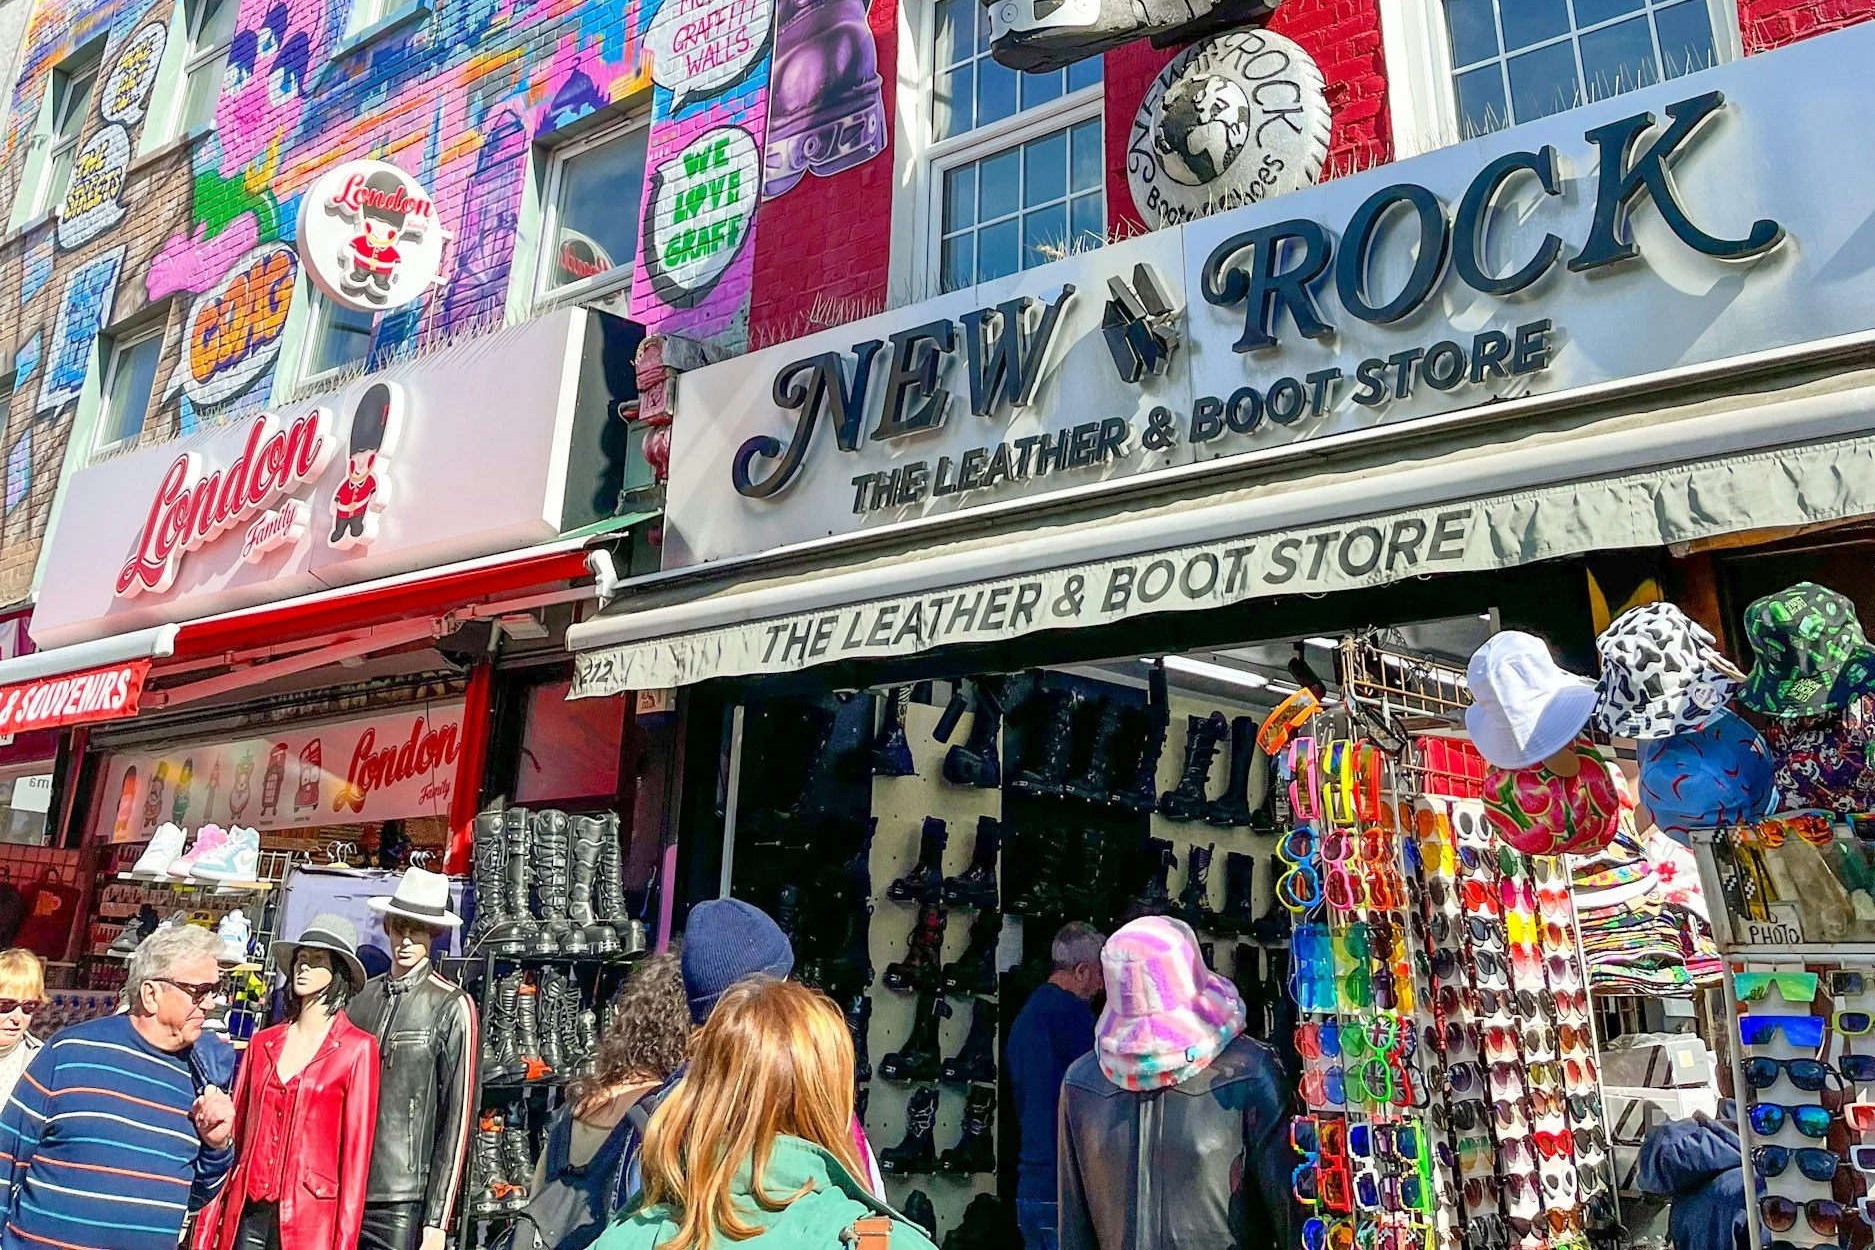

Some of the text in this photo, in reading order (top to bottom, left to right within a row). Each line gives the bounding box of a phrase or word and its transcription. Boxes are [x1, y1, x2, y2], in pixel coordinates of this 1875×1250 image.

[686, 26, 755, 77] WALLS.
[1223, 31, 1304, 149] ROCK
[683, 137, 731, 180] WE
[332, 172, 434, 218] London
[672, 168, 741, 225] LOVE
[663, 214, 744, 268] GRAFF
[732, 90, 1787, 499] NEW ROCK
[851, 318, 1554, 515] THE LEATHER & BOOT STORE
[115, 409, 323, 595] London
[242, 502, 297, 558] Family
[761, 508, 1472, 664] THE LEATHER & BOOT STORE
[15, 667, 132, 723] SOUVENIRS
[580, 658, 614, 685] 212
[332, 715, 461, 814] London
[418, 777, 451, 806] Family
[1748, 923, 1801, 945] PHOTO
